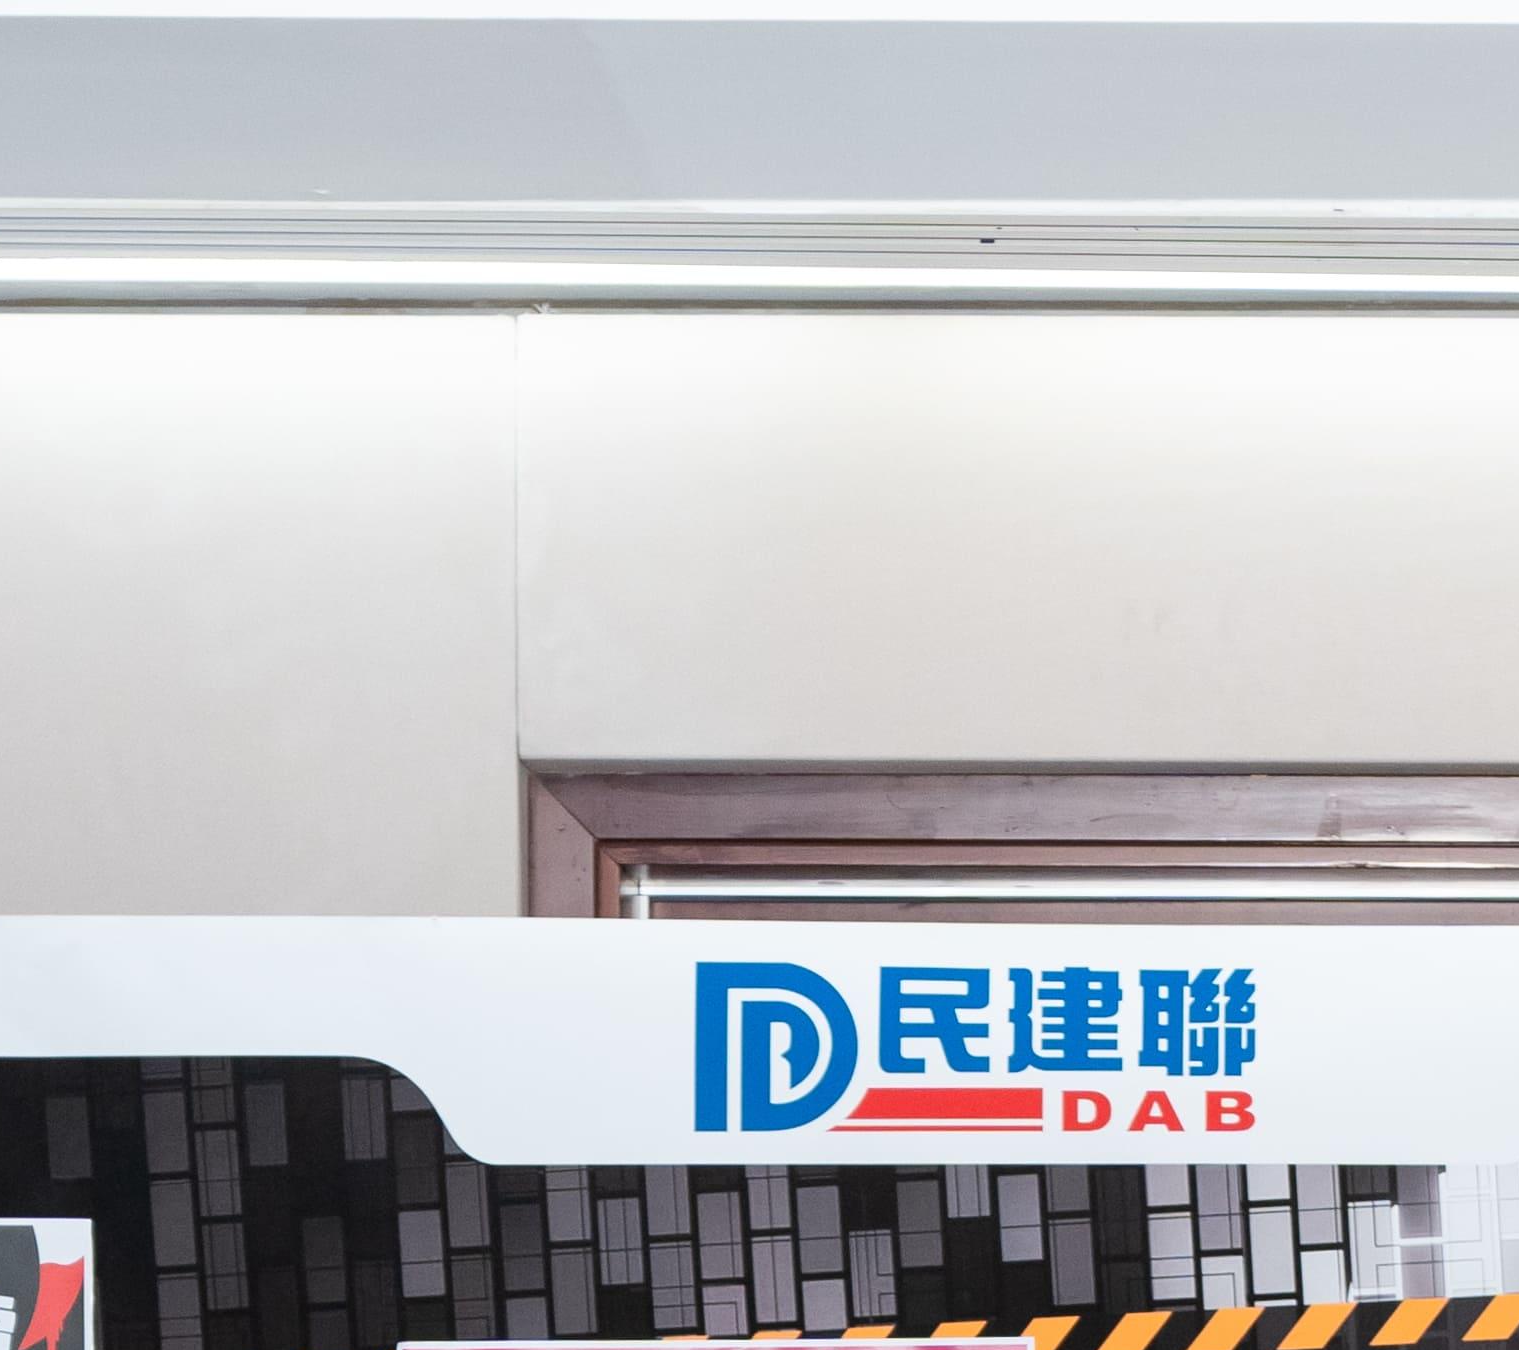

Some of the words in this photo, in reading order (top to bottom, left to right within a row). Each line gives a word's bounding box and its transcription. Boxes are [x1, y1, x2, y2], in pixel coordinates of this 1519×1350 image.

[878, 966, 1257, 1076] 民建聯
[1062, 1090, 1256, 1132] DAB
